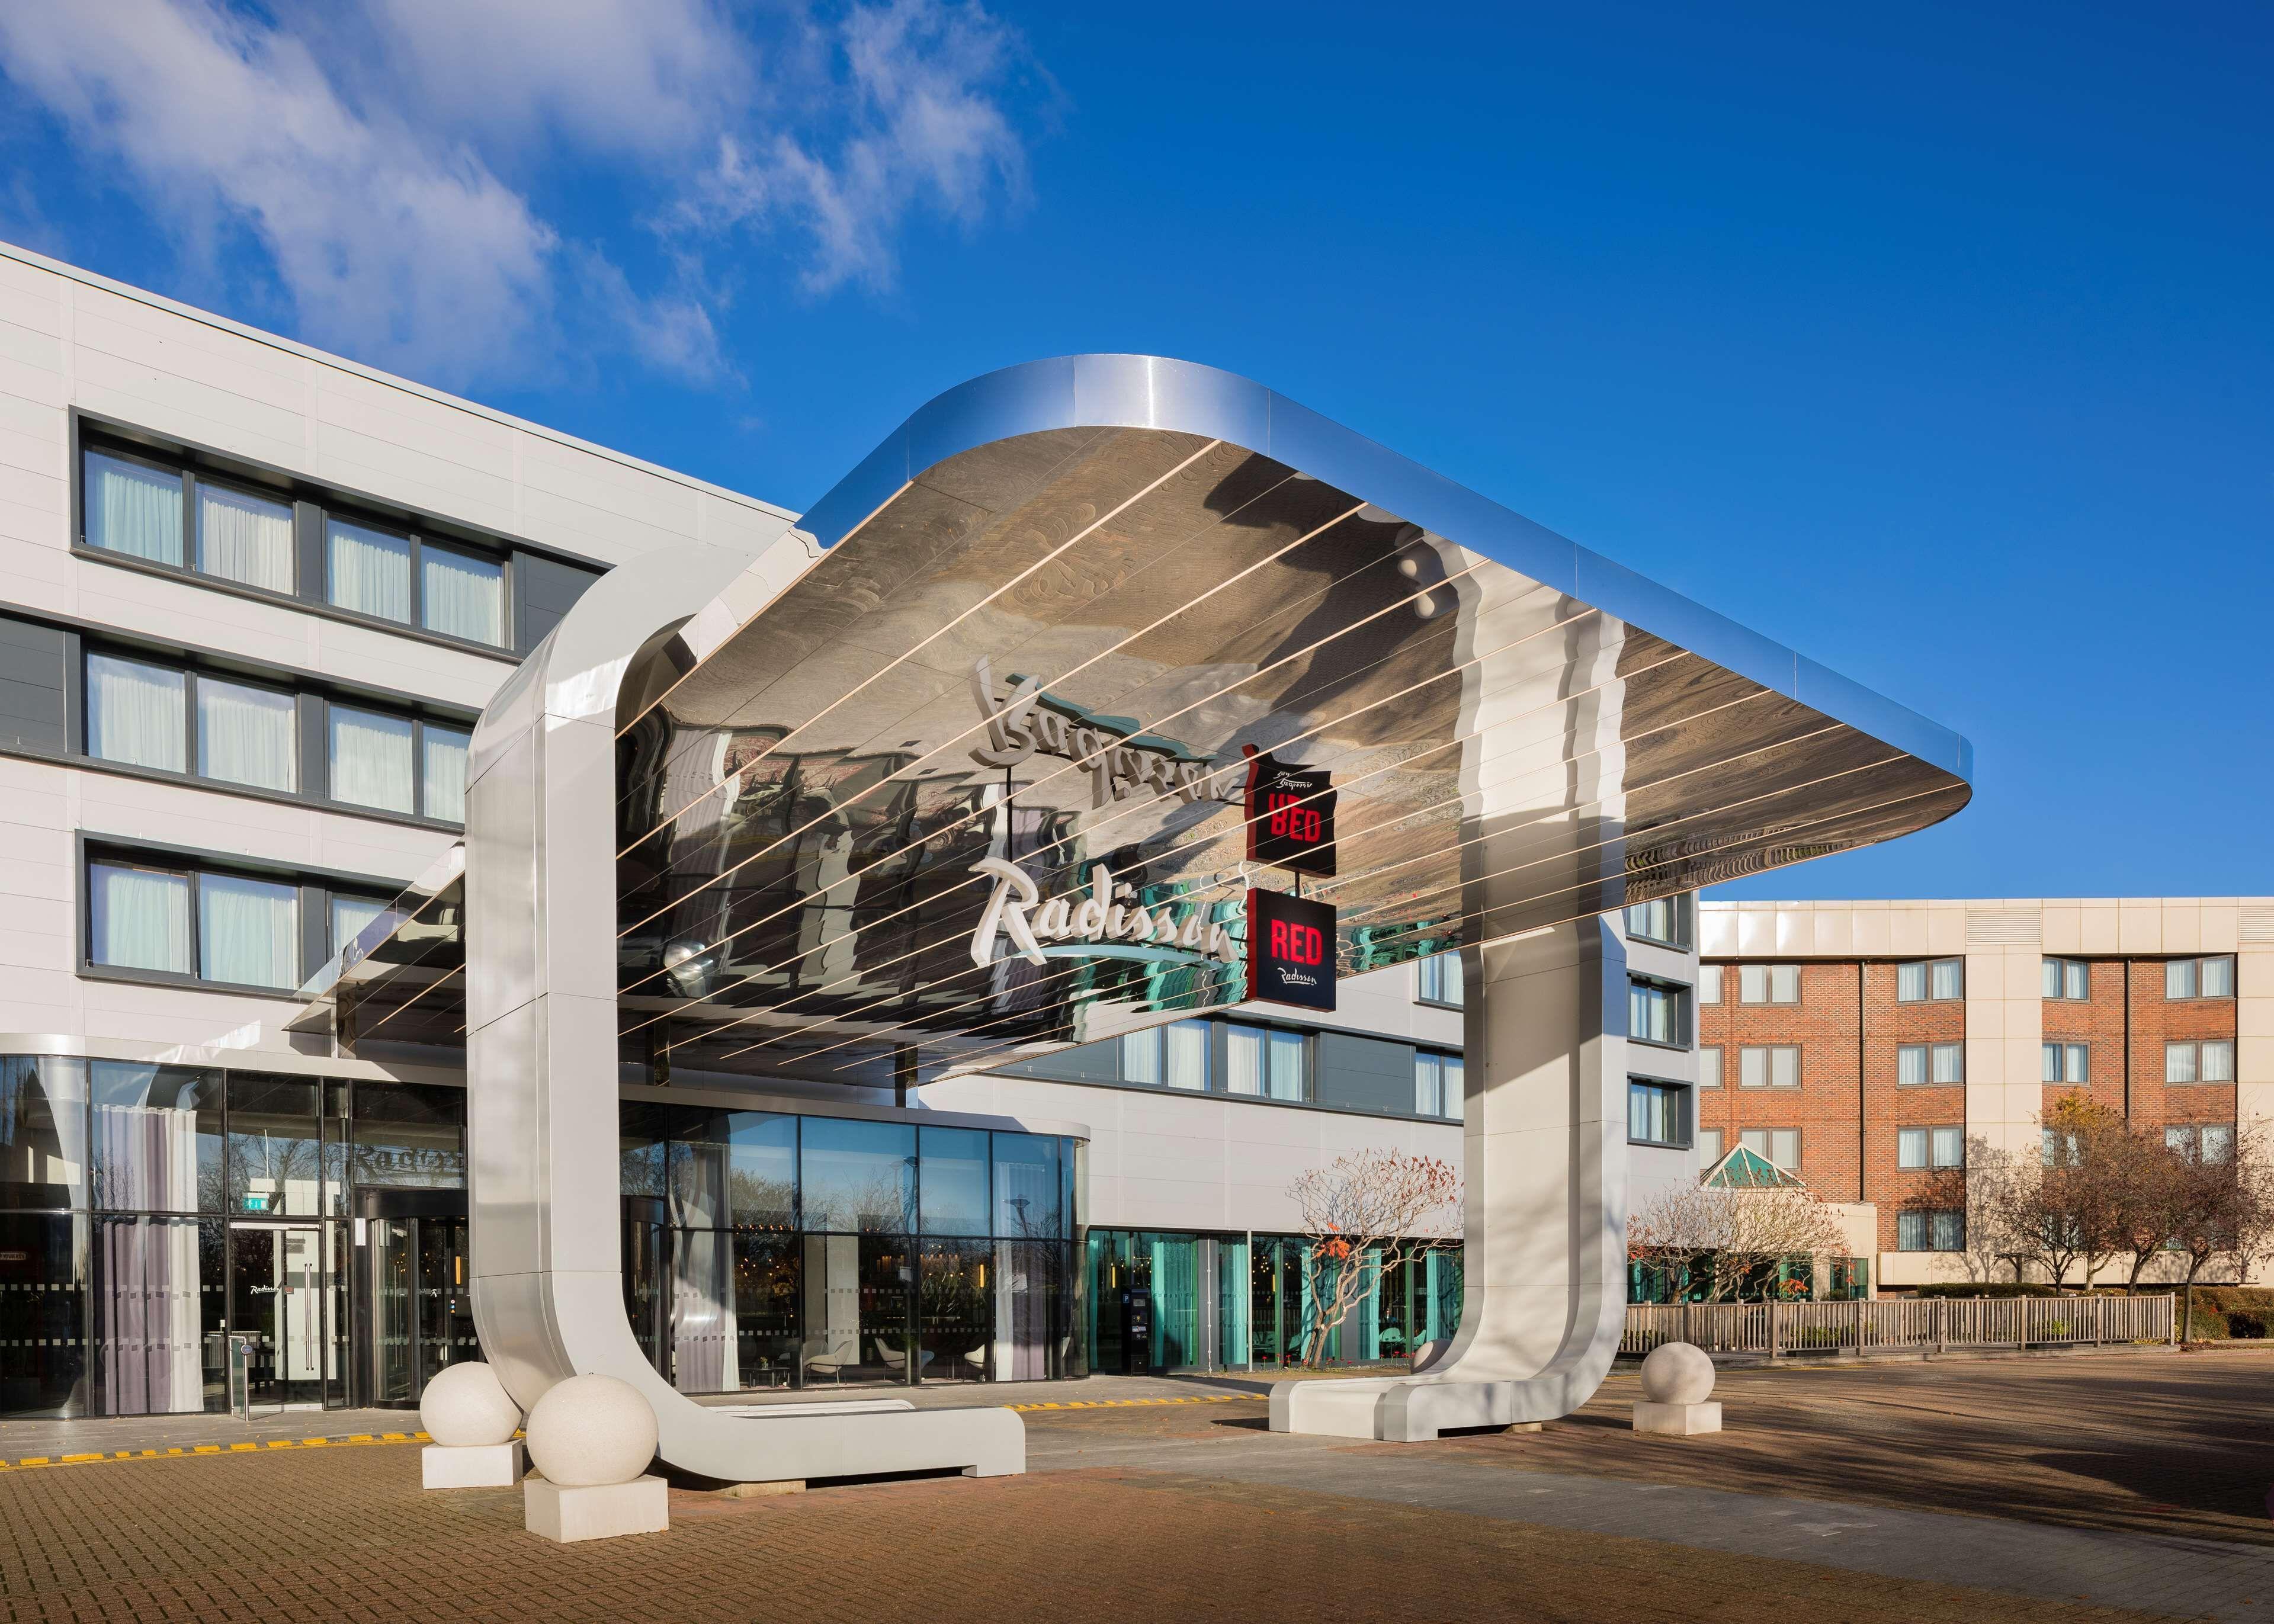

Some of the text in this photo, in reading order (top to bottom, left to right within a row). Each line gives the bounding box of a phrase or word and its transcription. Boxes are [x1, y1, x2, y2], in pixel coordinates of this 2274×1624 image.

[968, 856, 1240, 968] Radisson
[1271, 919, 1323, 966] RED
[1277, 967, 1317, 986] Radisson
[250, 1285, 281, 1295] Radisson
